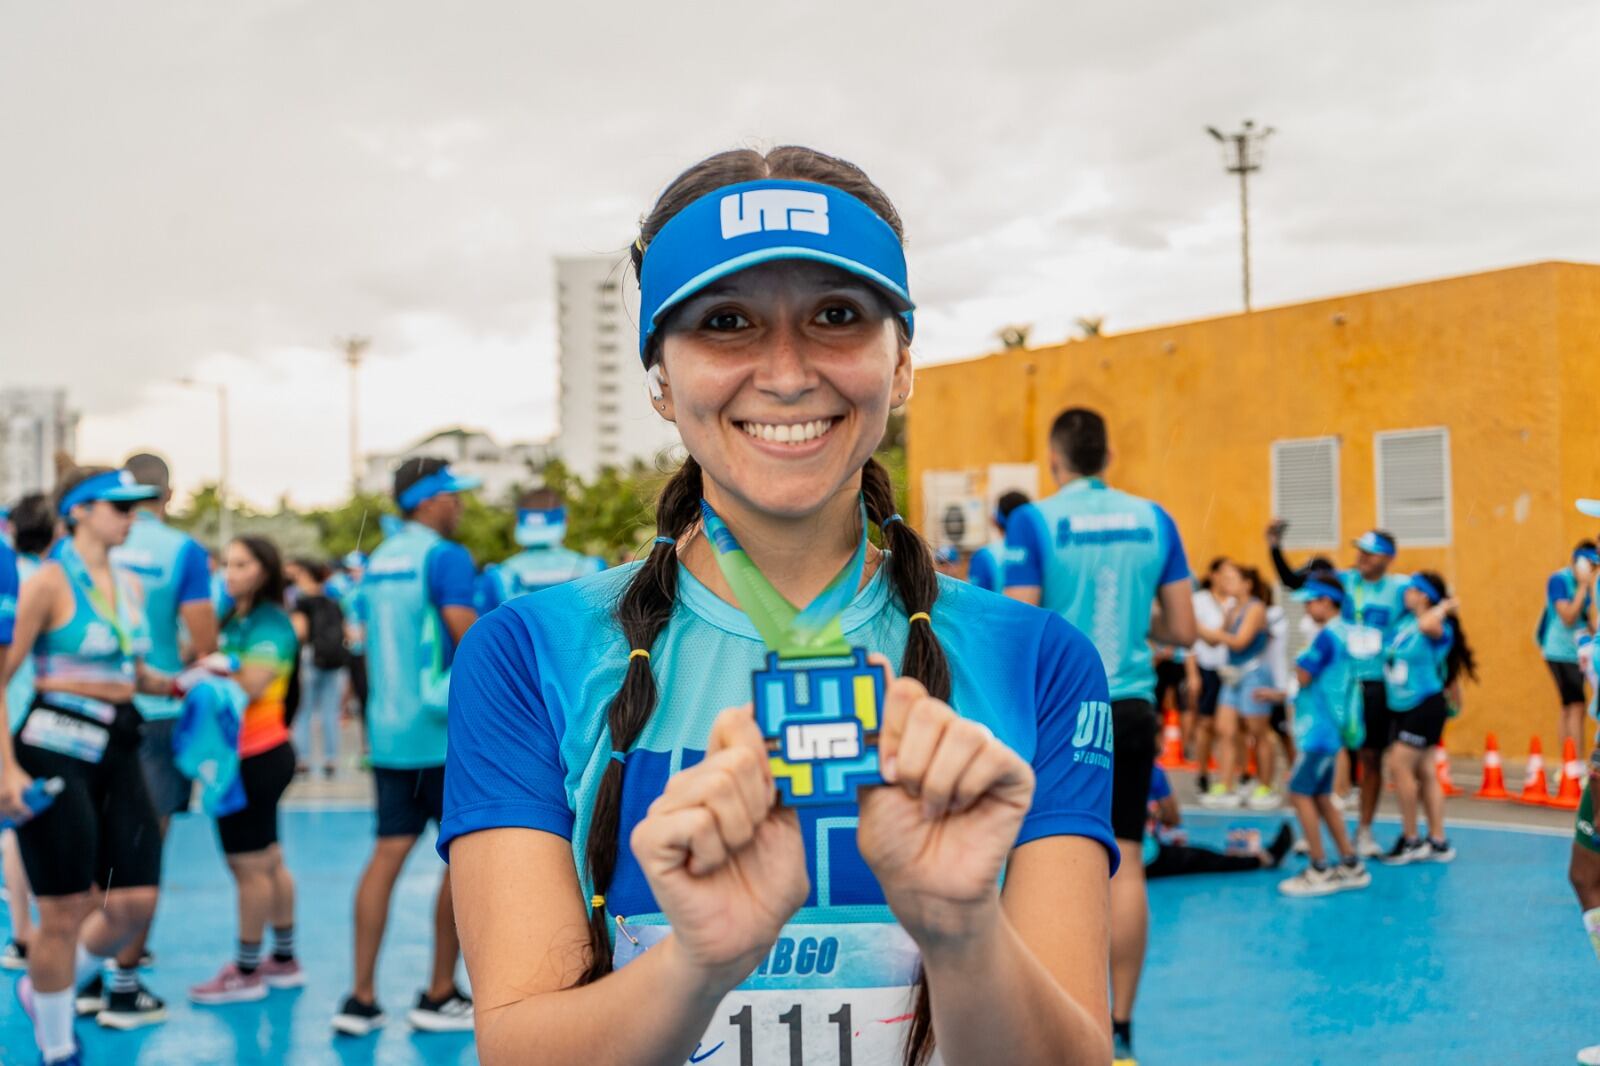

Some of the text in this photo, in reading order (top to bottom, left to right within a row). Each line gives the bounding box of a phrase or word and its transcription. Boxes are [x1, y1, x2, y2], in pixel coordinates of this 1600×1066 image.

[720, 188, 830, 240] UTB
[786, 721, 860, 761] UTB
[729, 1003, 852, 1066] 111
